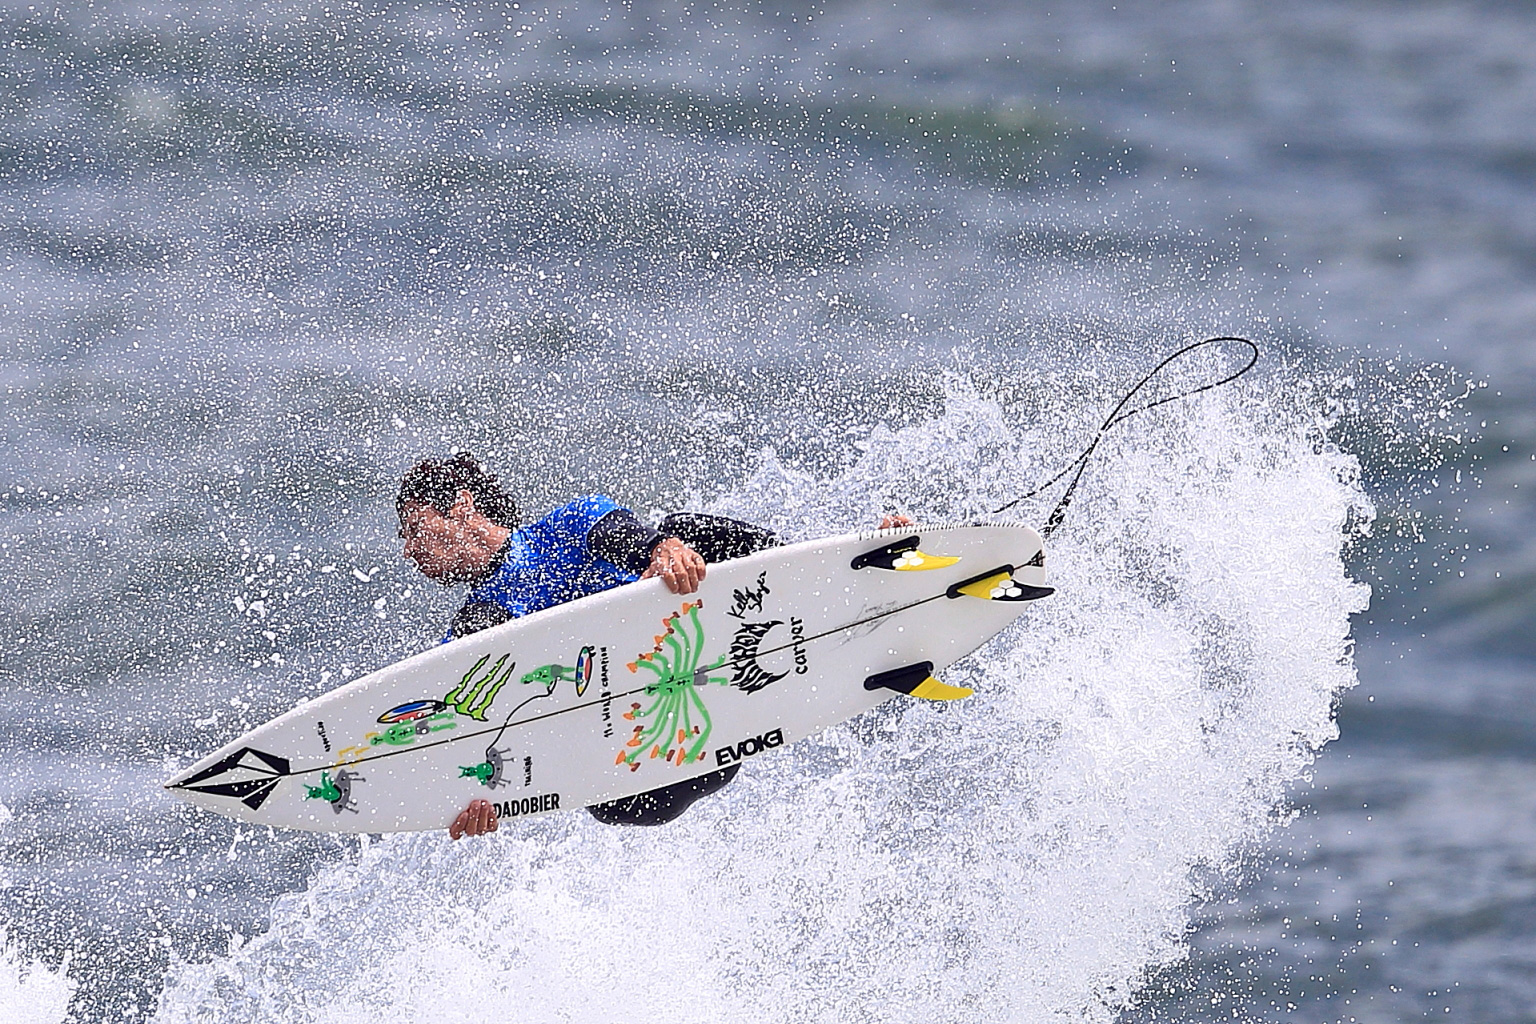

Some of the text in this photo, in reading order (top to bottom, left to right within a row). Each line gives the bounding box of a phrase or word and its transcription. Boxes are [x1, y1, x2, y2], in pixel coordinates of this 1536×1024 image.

[727, 586, 758, 619] Kelly
[790, 617, 808, 674] carver
[715, 728, 784, 766] EVOKE
[493, 793, 561, 819] DADOBIER
